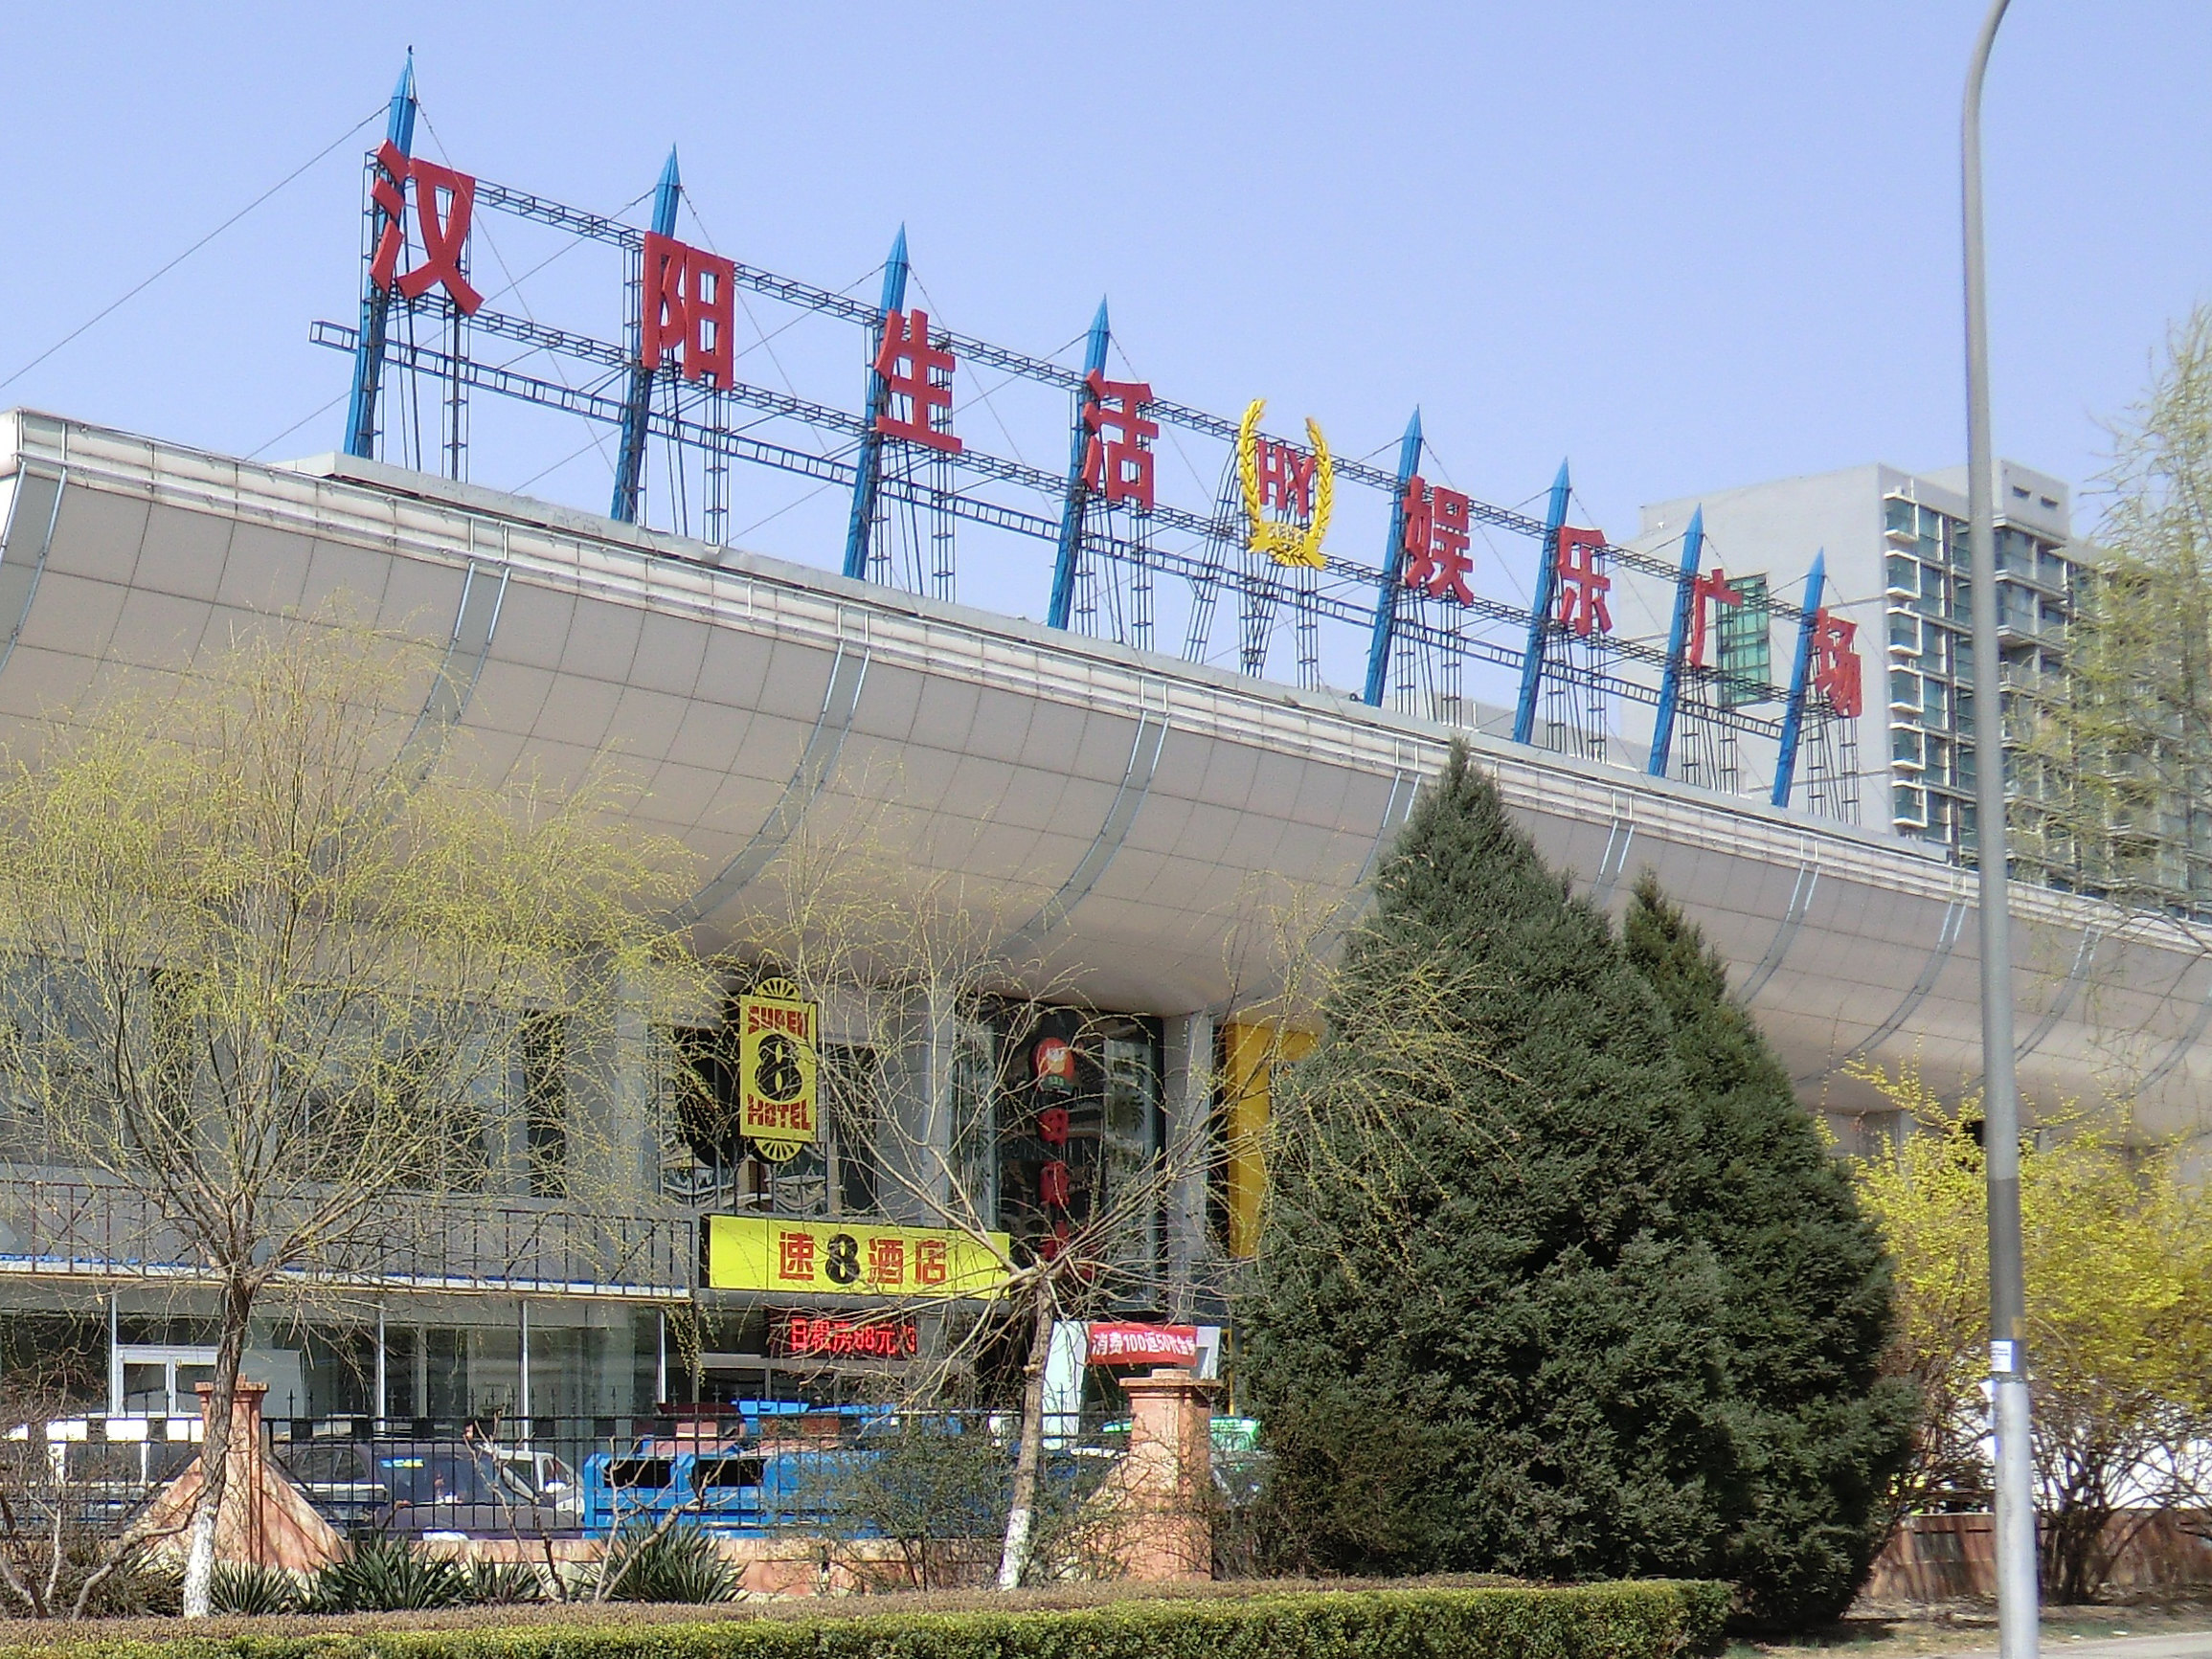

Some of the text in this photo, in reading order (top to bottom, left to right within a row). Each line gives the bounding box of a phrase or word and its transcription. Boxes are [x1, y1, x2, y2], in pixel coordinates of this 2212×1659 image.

[1256, 439, 1318, 518] HY
[748, 1005, 809, 1040] SUPER
[755, 1034, 802, 1102] 8
[748, 1093, 812, 1131] HOTEL
[779, 1231, 947, 1285] 速8酒店
